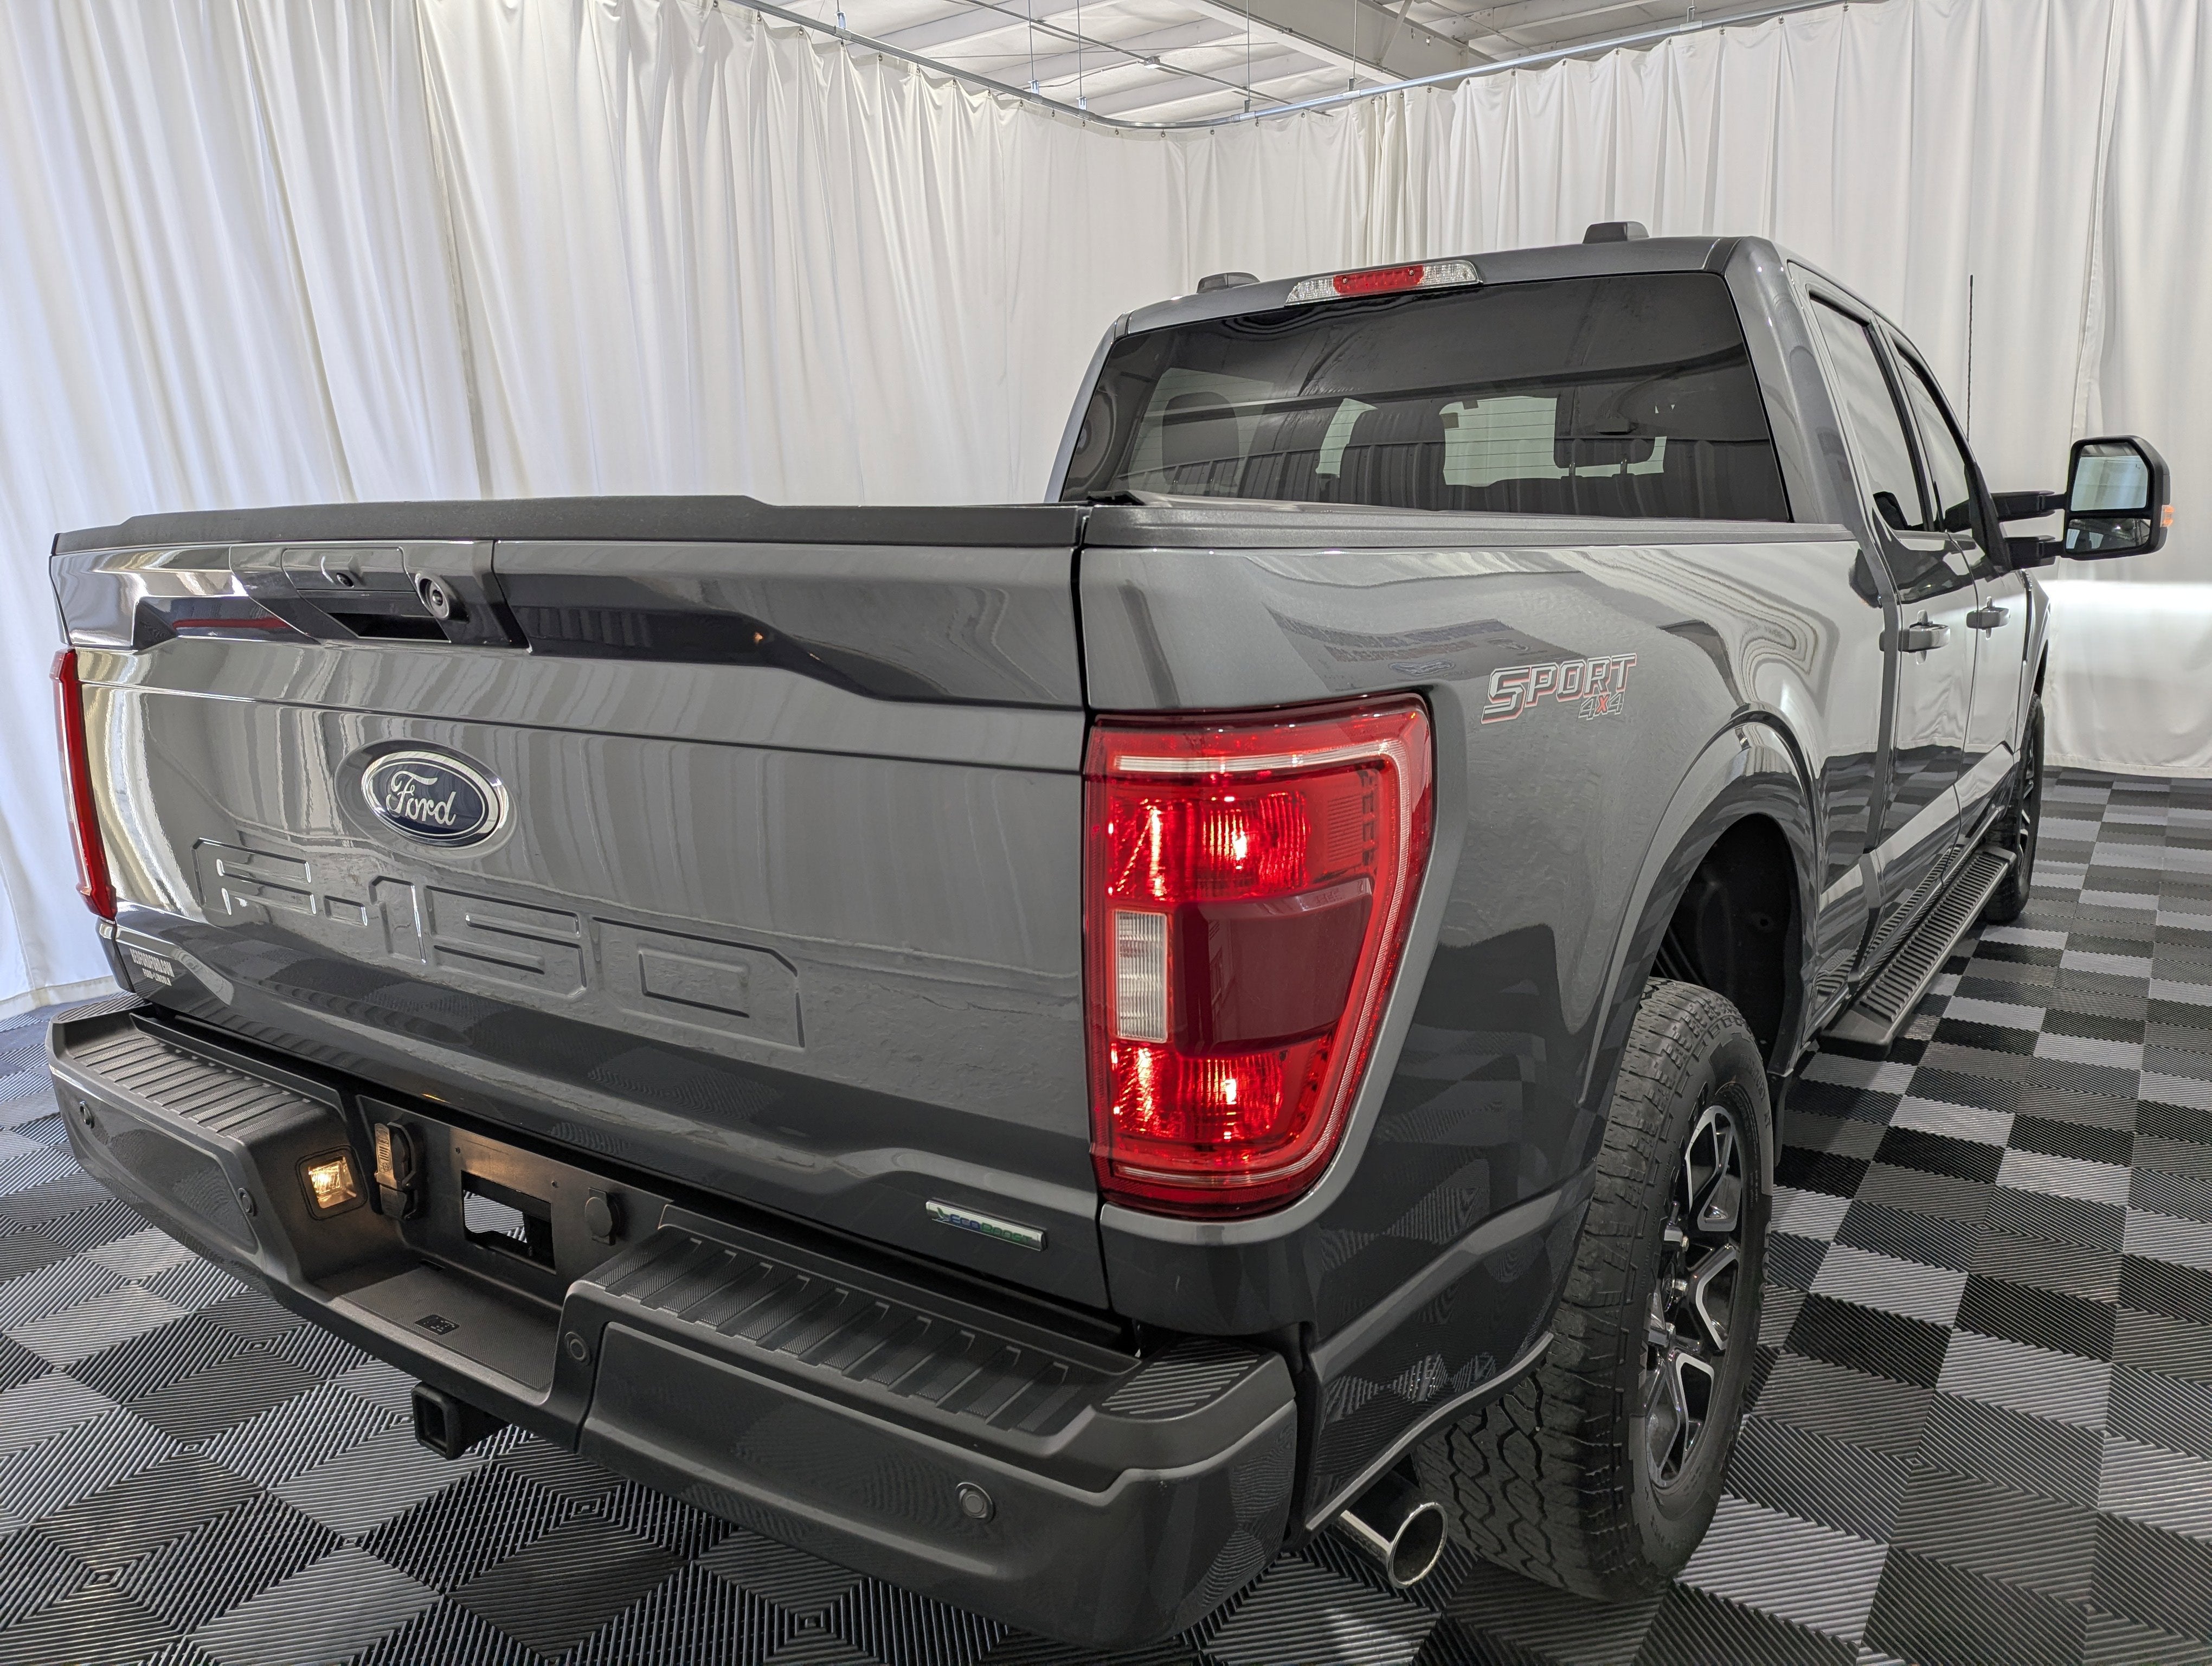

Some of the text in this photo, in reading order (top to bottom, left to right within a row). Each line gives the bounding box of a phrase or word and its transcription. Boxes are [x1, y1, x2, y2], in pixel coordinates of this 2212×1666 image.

[1481, 652, 1637, 725] SPORT
[385, 770, 457, 826] Ford
[191, 837, 806, 1052] F-150
